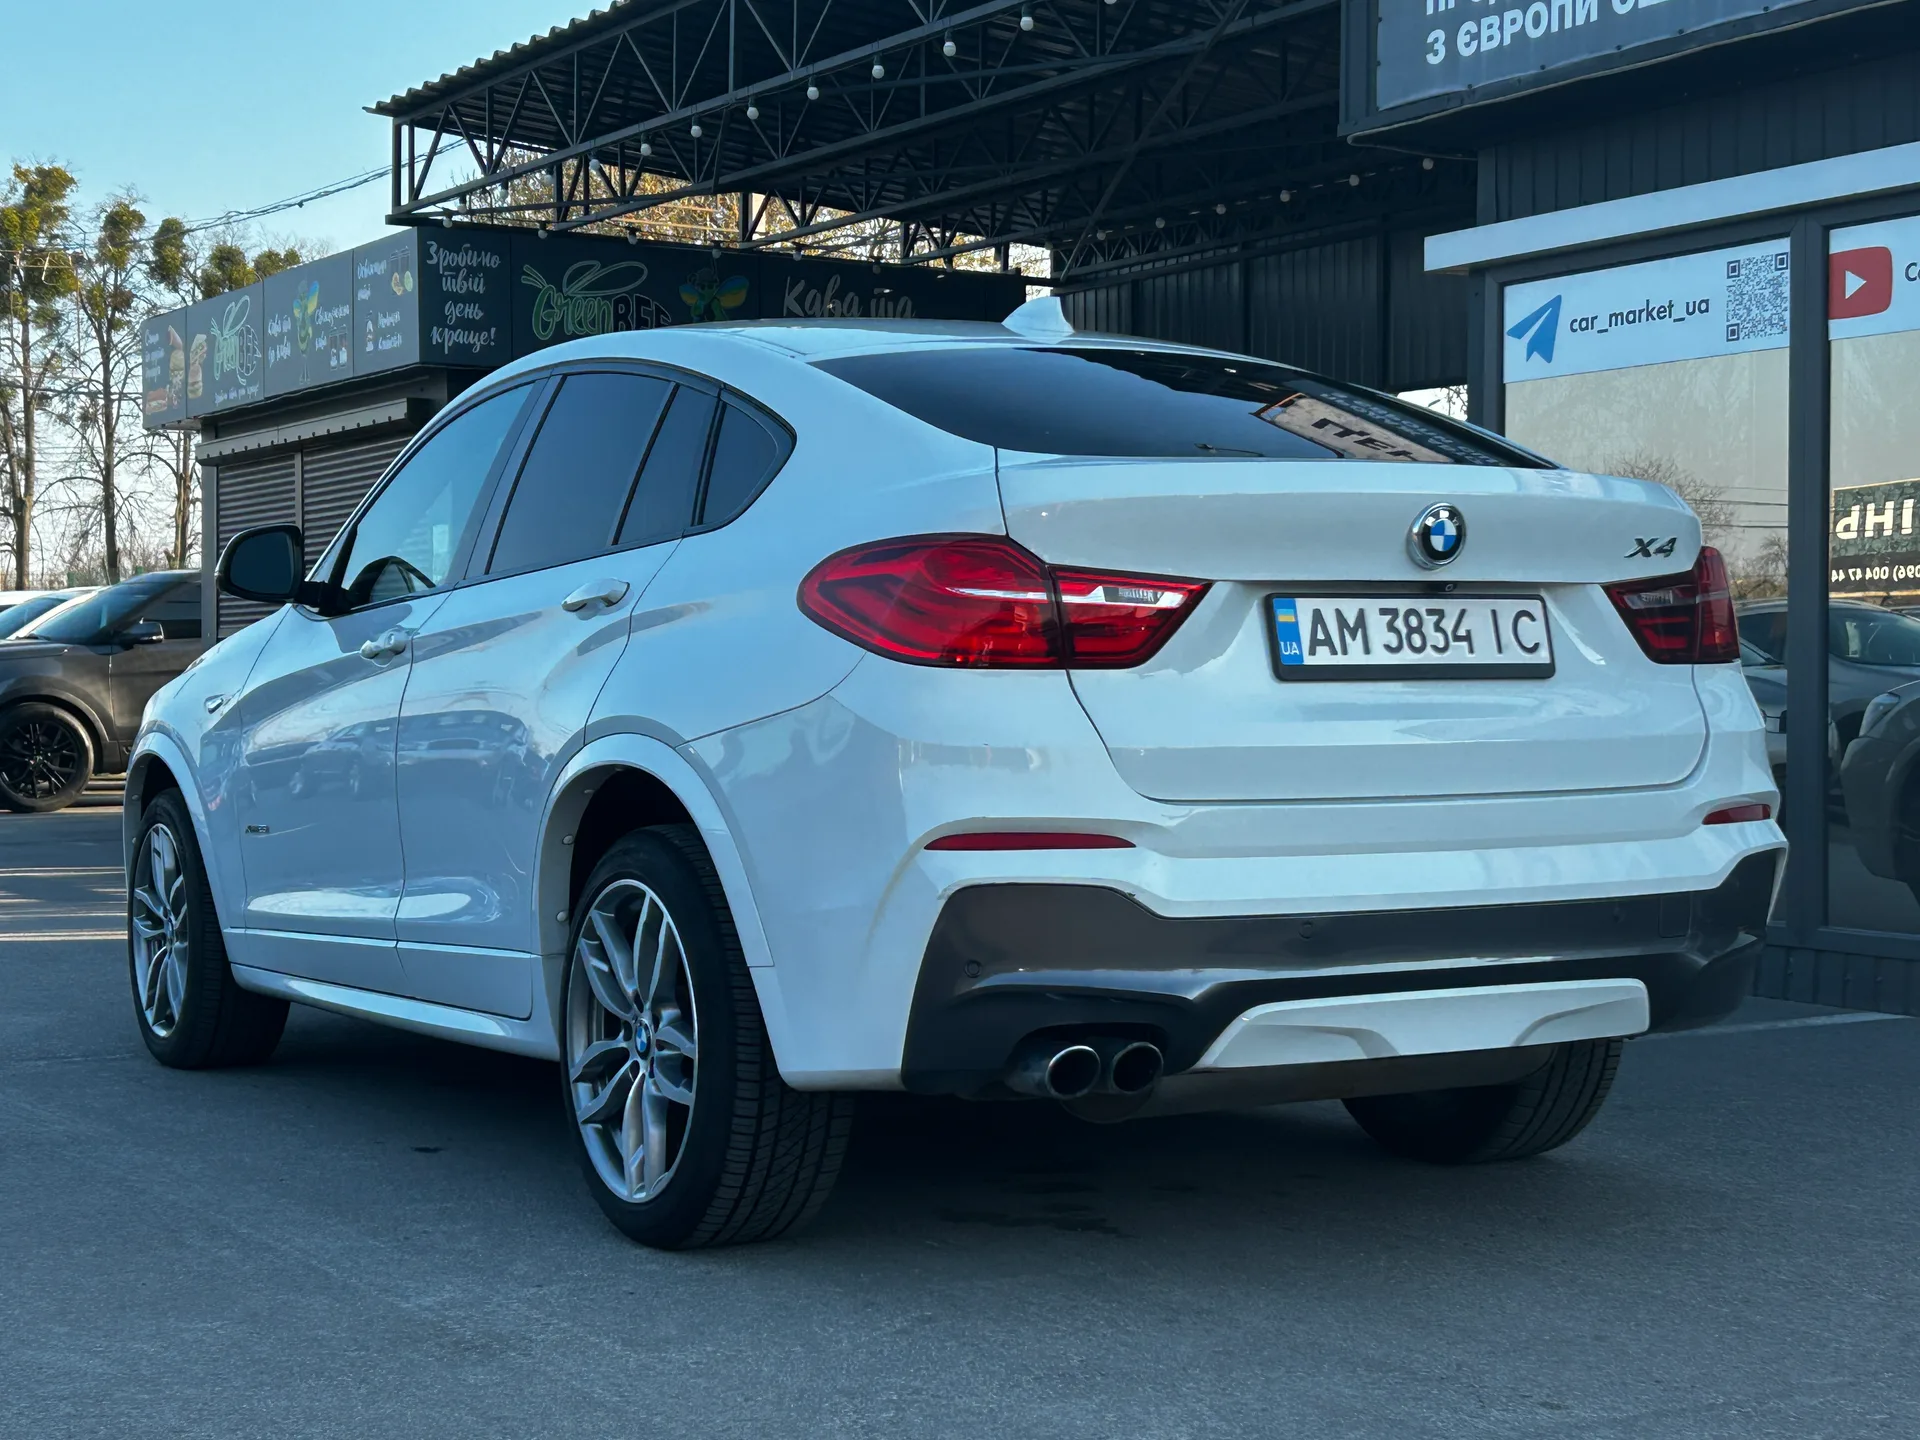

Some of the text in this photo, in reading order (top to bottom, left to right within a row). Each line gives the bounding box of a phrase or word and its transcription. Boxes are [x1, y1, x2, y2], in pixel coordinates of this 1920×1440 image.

[1426, 0, 1598, 65] З ЄВРОПИ
[426, 241, 501, 275] Зробимо
[1904, 261, 1920, 282] C
[442, 267, 486, 294] твій
[783, 274, 863, 318] Кава
[444, 300, 485, 326] день
[1569, 298, 1710, 334] car_market_ua
[430, 326, 498, 355] краще!
[1623, 537, 1678, 559] X4
[1308, 607, 1371, 656] AM
[1378, 606, 1475, 655] 3834
[1280, 641, 1300, 657] UA
